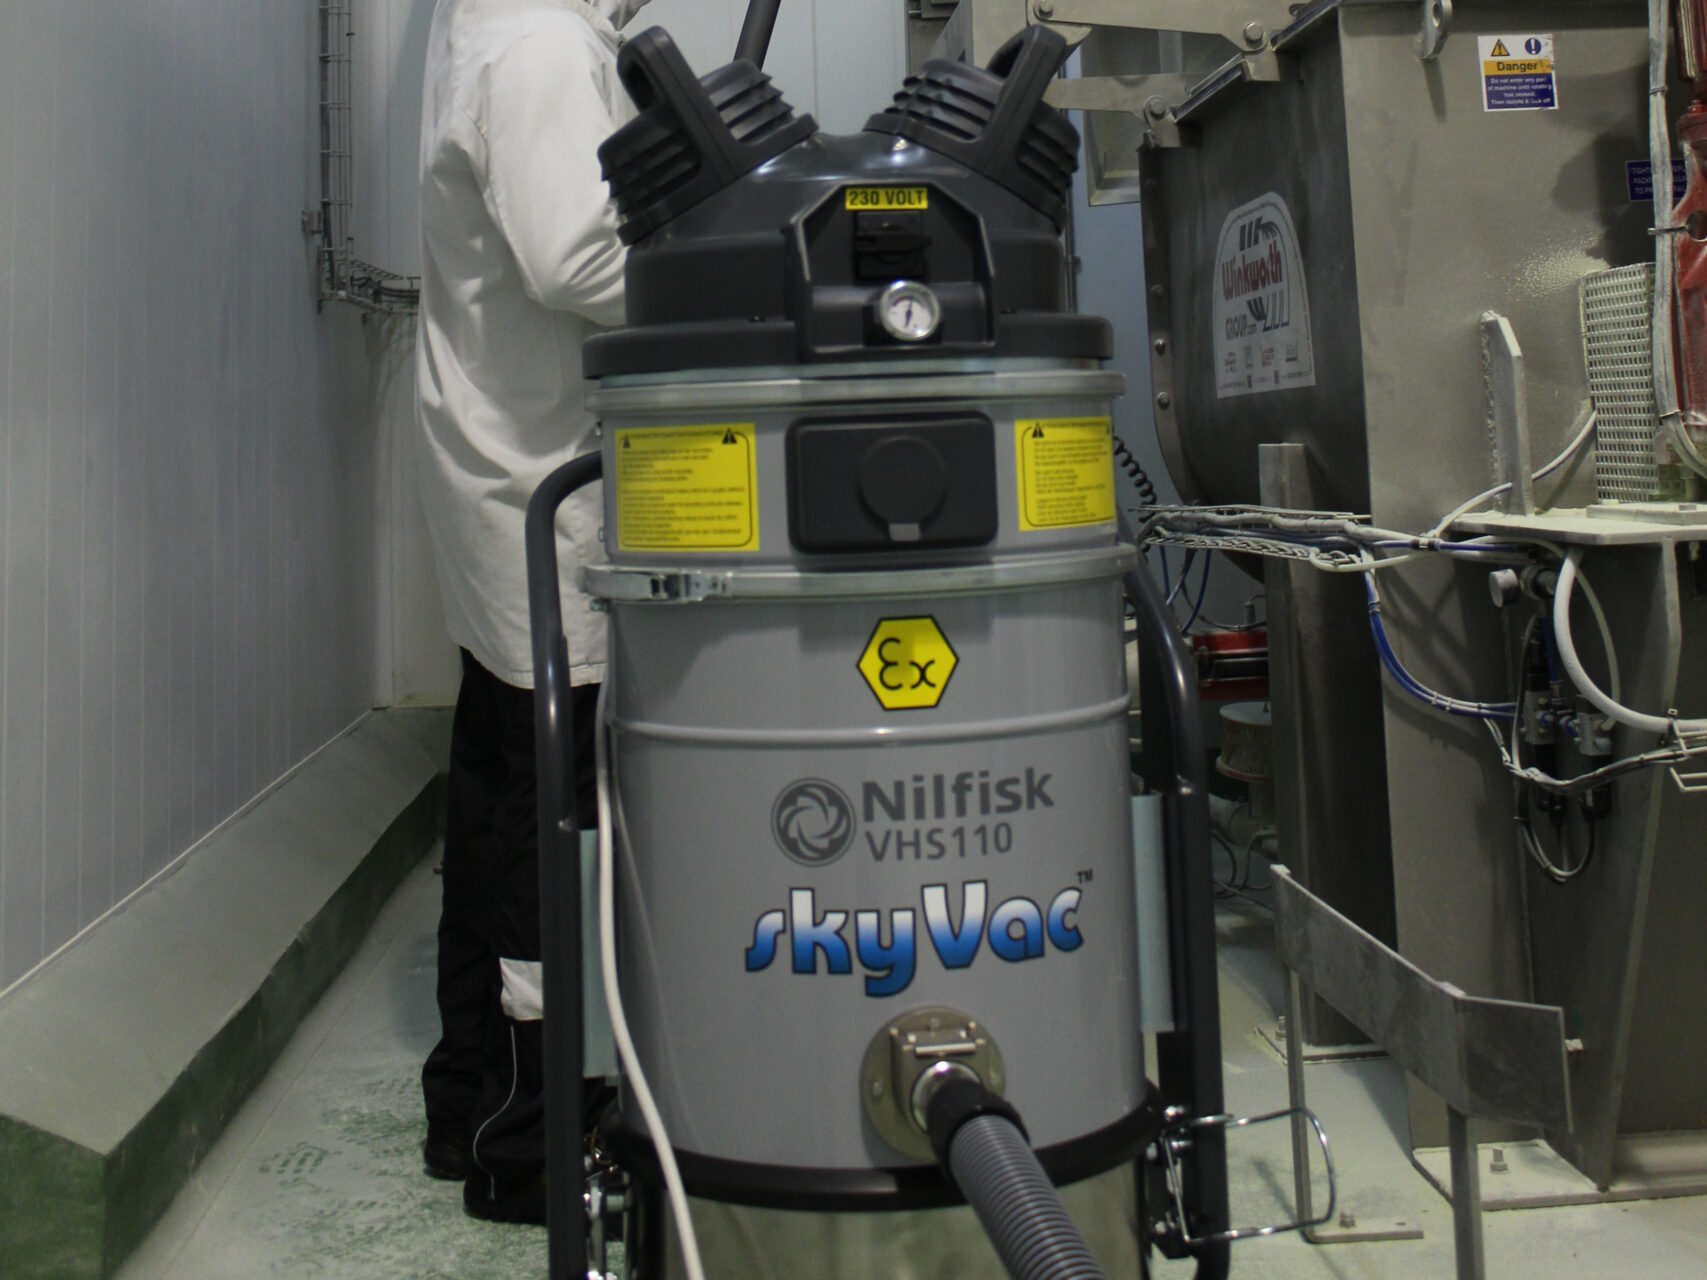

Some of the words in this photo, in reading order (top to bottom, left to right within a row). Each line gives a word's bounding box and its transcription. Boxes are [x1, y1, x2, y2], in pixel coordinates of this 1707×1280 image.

[1496, 61, 1538, 73] Danger
[849, 190, 880, 206] 230
[885, 189, 925, 206] VOLT
[1222, 239, 1283, 301] Winkworth
[863, 767, 1055, 822] Nilfisk
[865, 822, 1013, 862] VHS110
